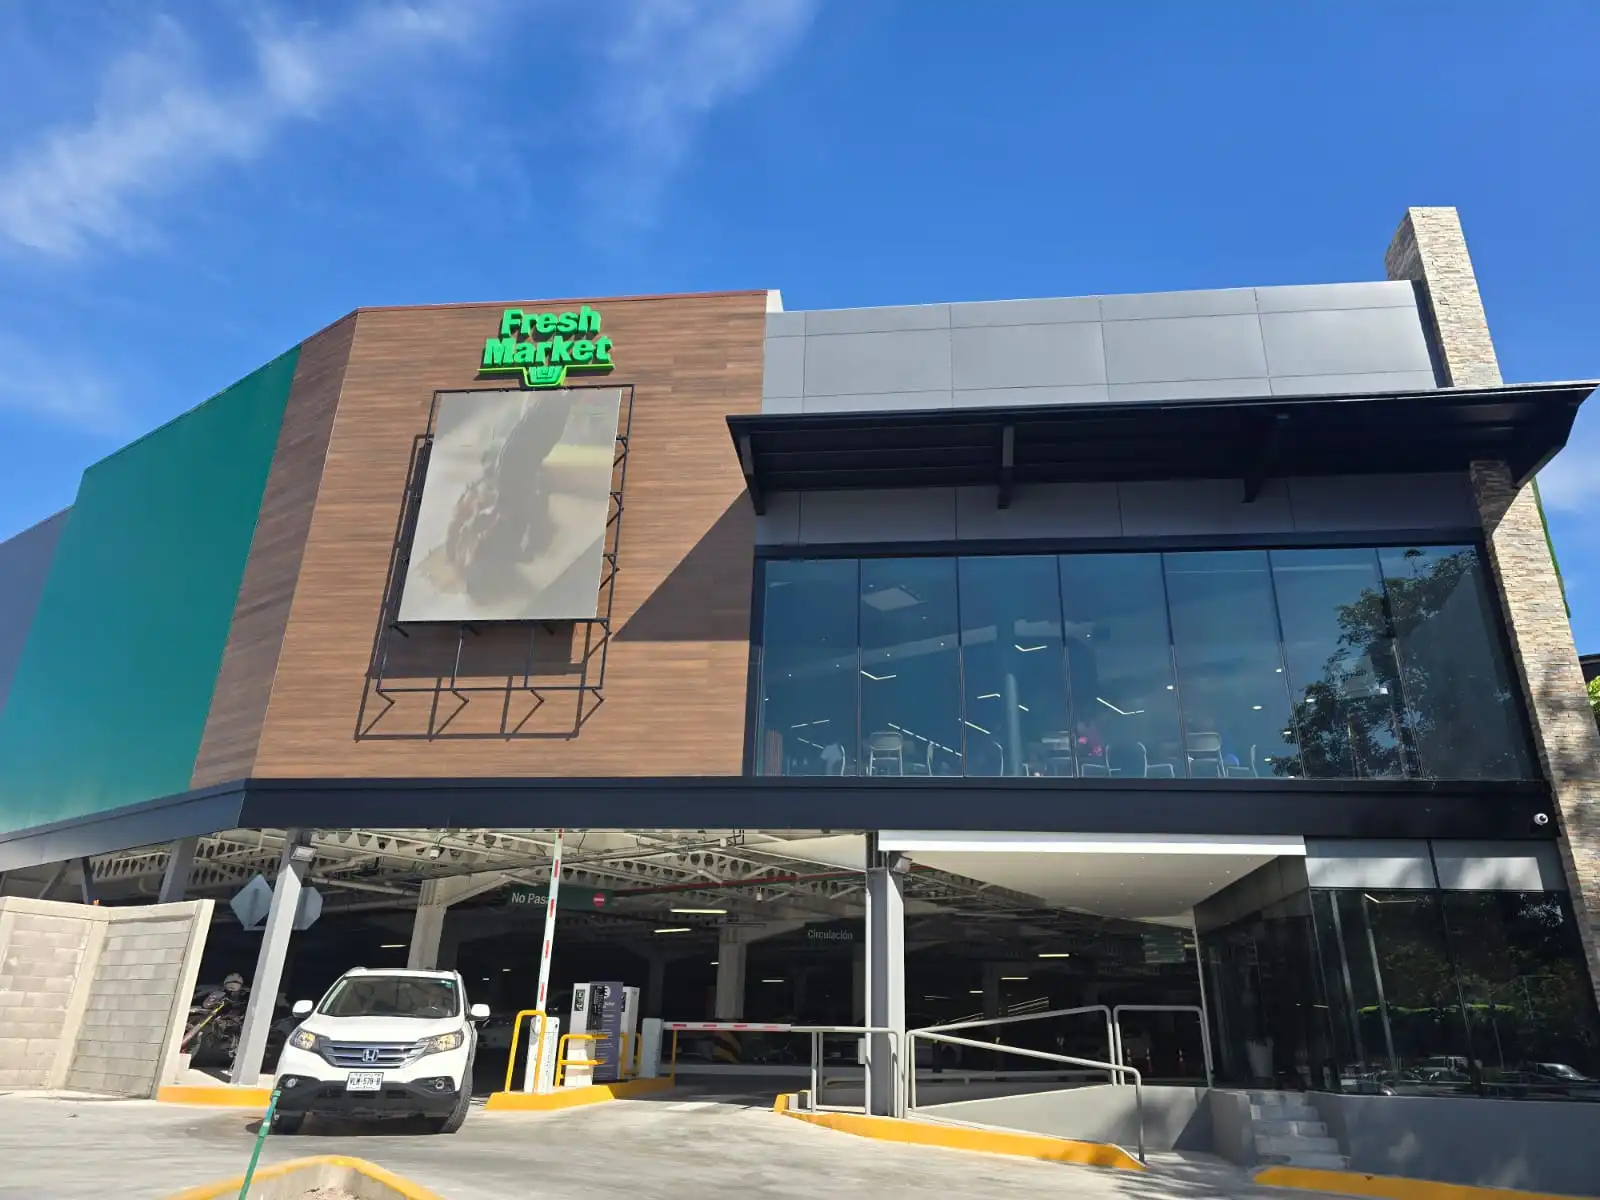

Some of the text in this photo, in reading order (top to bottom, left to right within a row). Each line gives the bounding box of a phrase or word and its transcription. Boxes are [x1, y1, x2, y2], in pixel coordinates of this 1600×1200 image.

[500, 304, 602, 338] Fresh
[483, 335, 613, 366] Market
[511, 892, 549, 906] No Pas
[807, 928, 854, 941] Circulación
